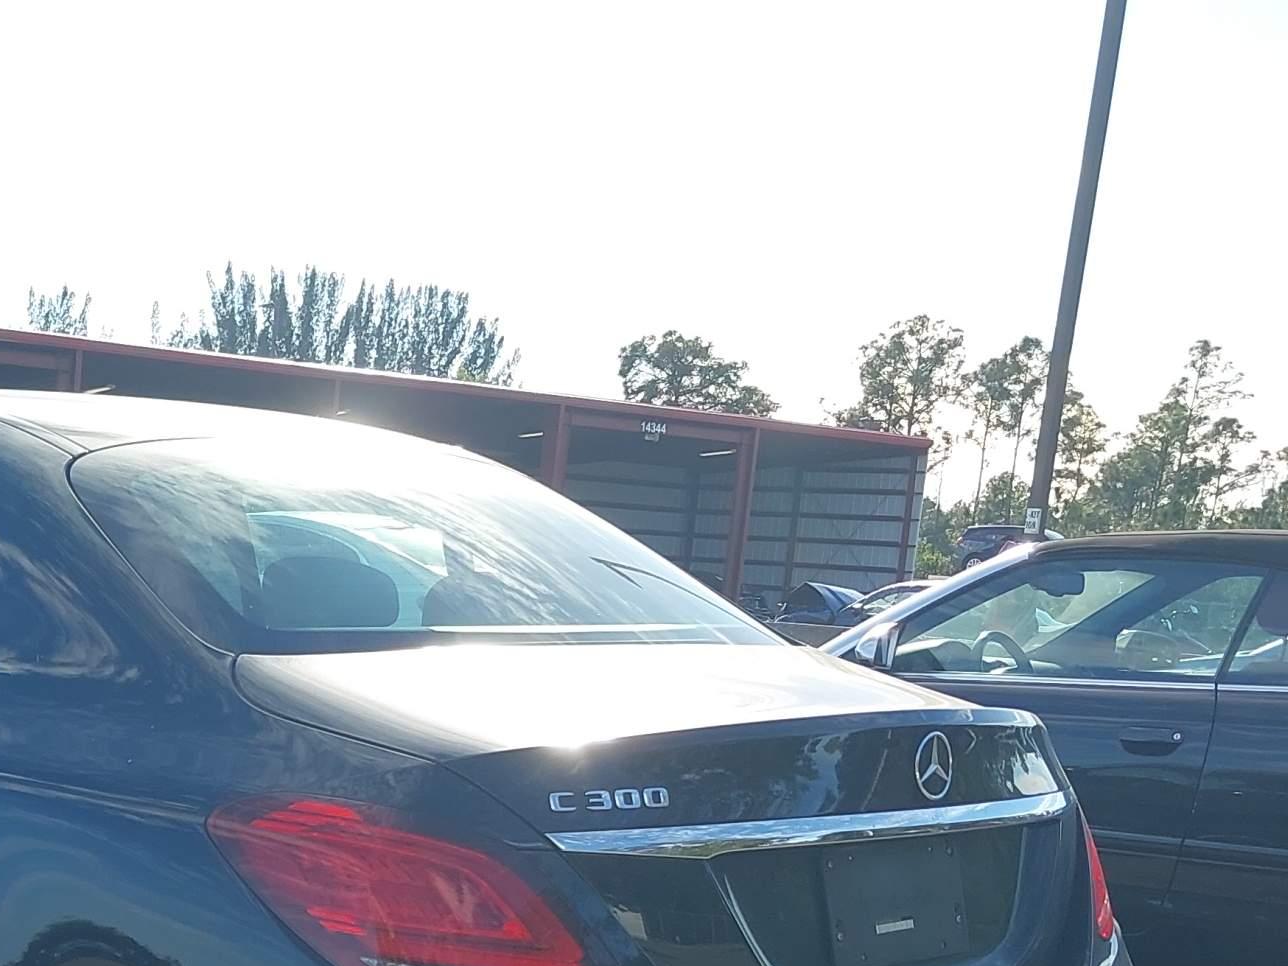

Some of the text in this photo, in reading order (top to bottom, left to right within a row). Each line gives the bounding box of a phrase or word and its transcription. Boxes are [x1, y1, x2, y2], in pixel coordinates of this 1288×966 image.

[641, 421, 666, 434] 14344
[549, 787, 670, 811] C 300
